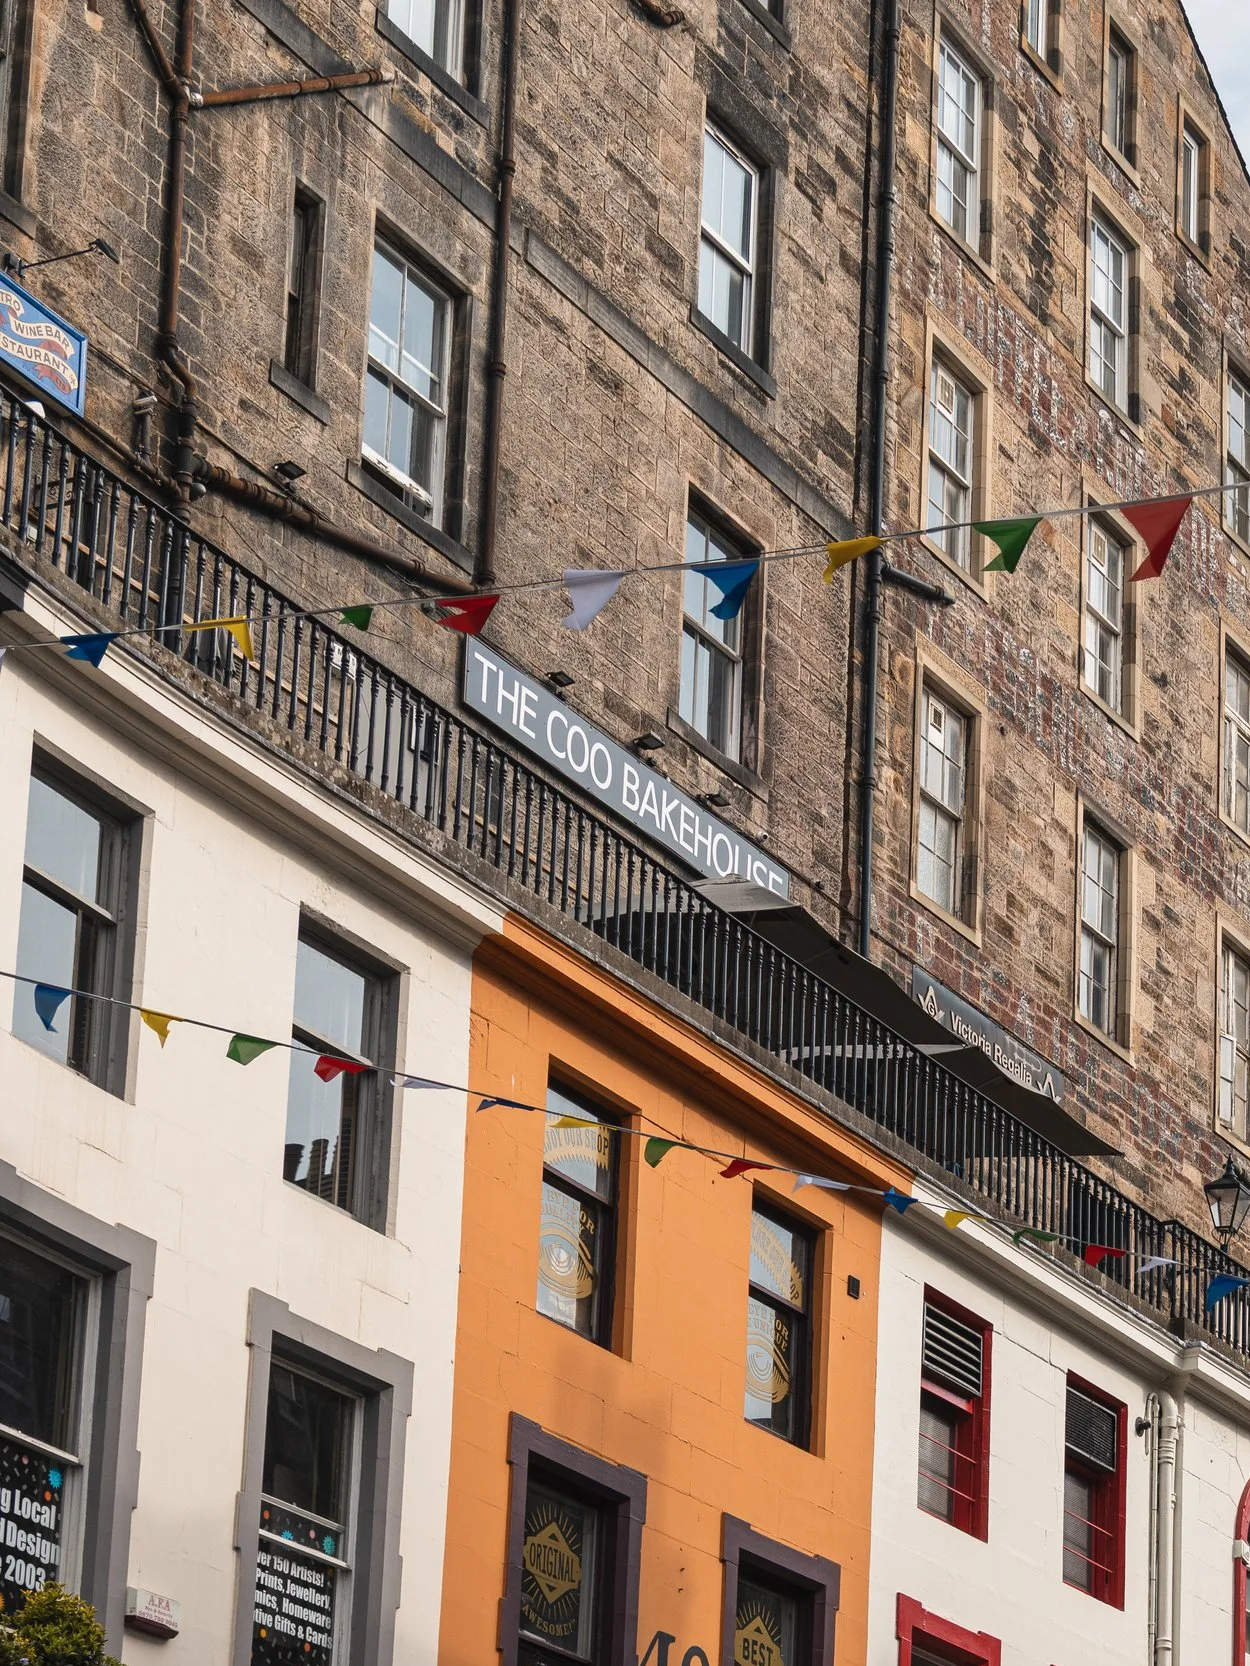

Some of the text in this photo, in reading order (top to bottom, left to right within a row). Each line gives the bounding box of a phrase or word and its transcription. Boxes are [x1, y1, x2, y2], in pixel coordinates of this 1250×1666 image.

[14, 320, 70, 350] WINE BAR
[474, 652, 784, 894] THE COO BAKEHOUSE
[950, 1011, 1033, 1087] Victoria Regalia
[14, 1488, 57, 1531] Local
[273, 1556, 290, 1575] 150
[290, 1561, 325, 1588] Artists!
[529, 1541, 577, 1585] ORIGINAL
[286, 1579, 332, 1611] Jewellery,
[282, 1597, 332, 1630] Homeware
[274, 1615, 297, 1637] Gifts
[297, 1625, 304, 1640] &
[305, 1626, 333, 1650] Cards
